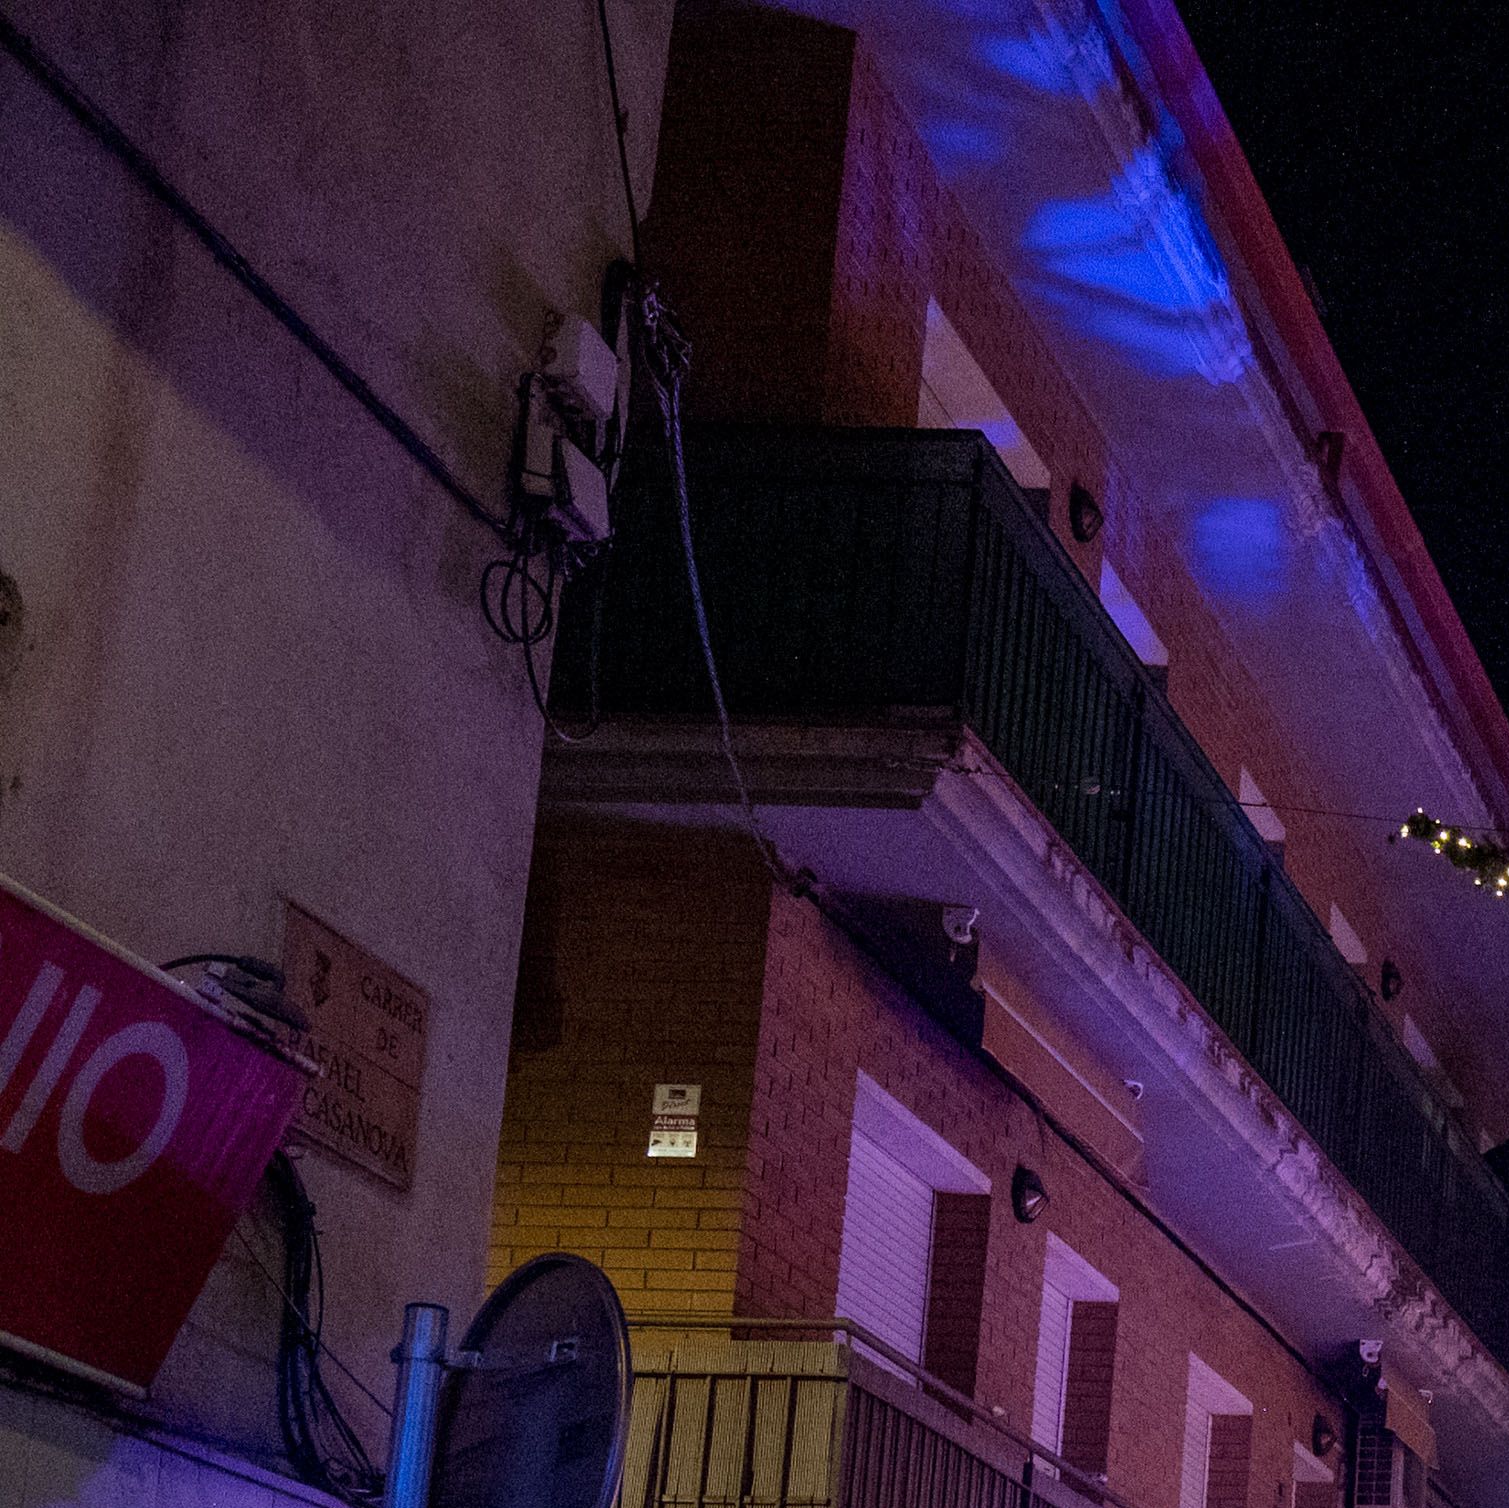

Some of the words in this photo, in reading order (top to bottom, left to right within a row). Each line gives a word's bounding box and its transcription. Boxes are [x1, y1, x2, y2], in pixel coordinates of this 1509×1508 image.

[361, 976, 423, 1034] CARRER
[376, 1027, 399, 1059] DE
[302, 1086, 408, 1173] CASANOVA
[654, 1116, 696, 1125] Alarma
